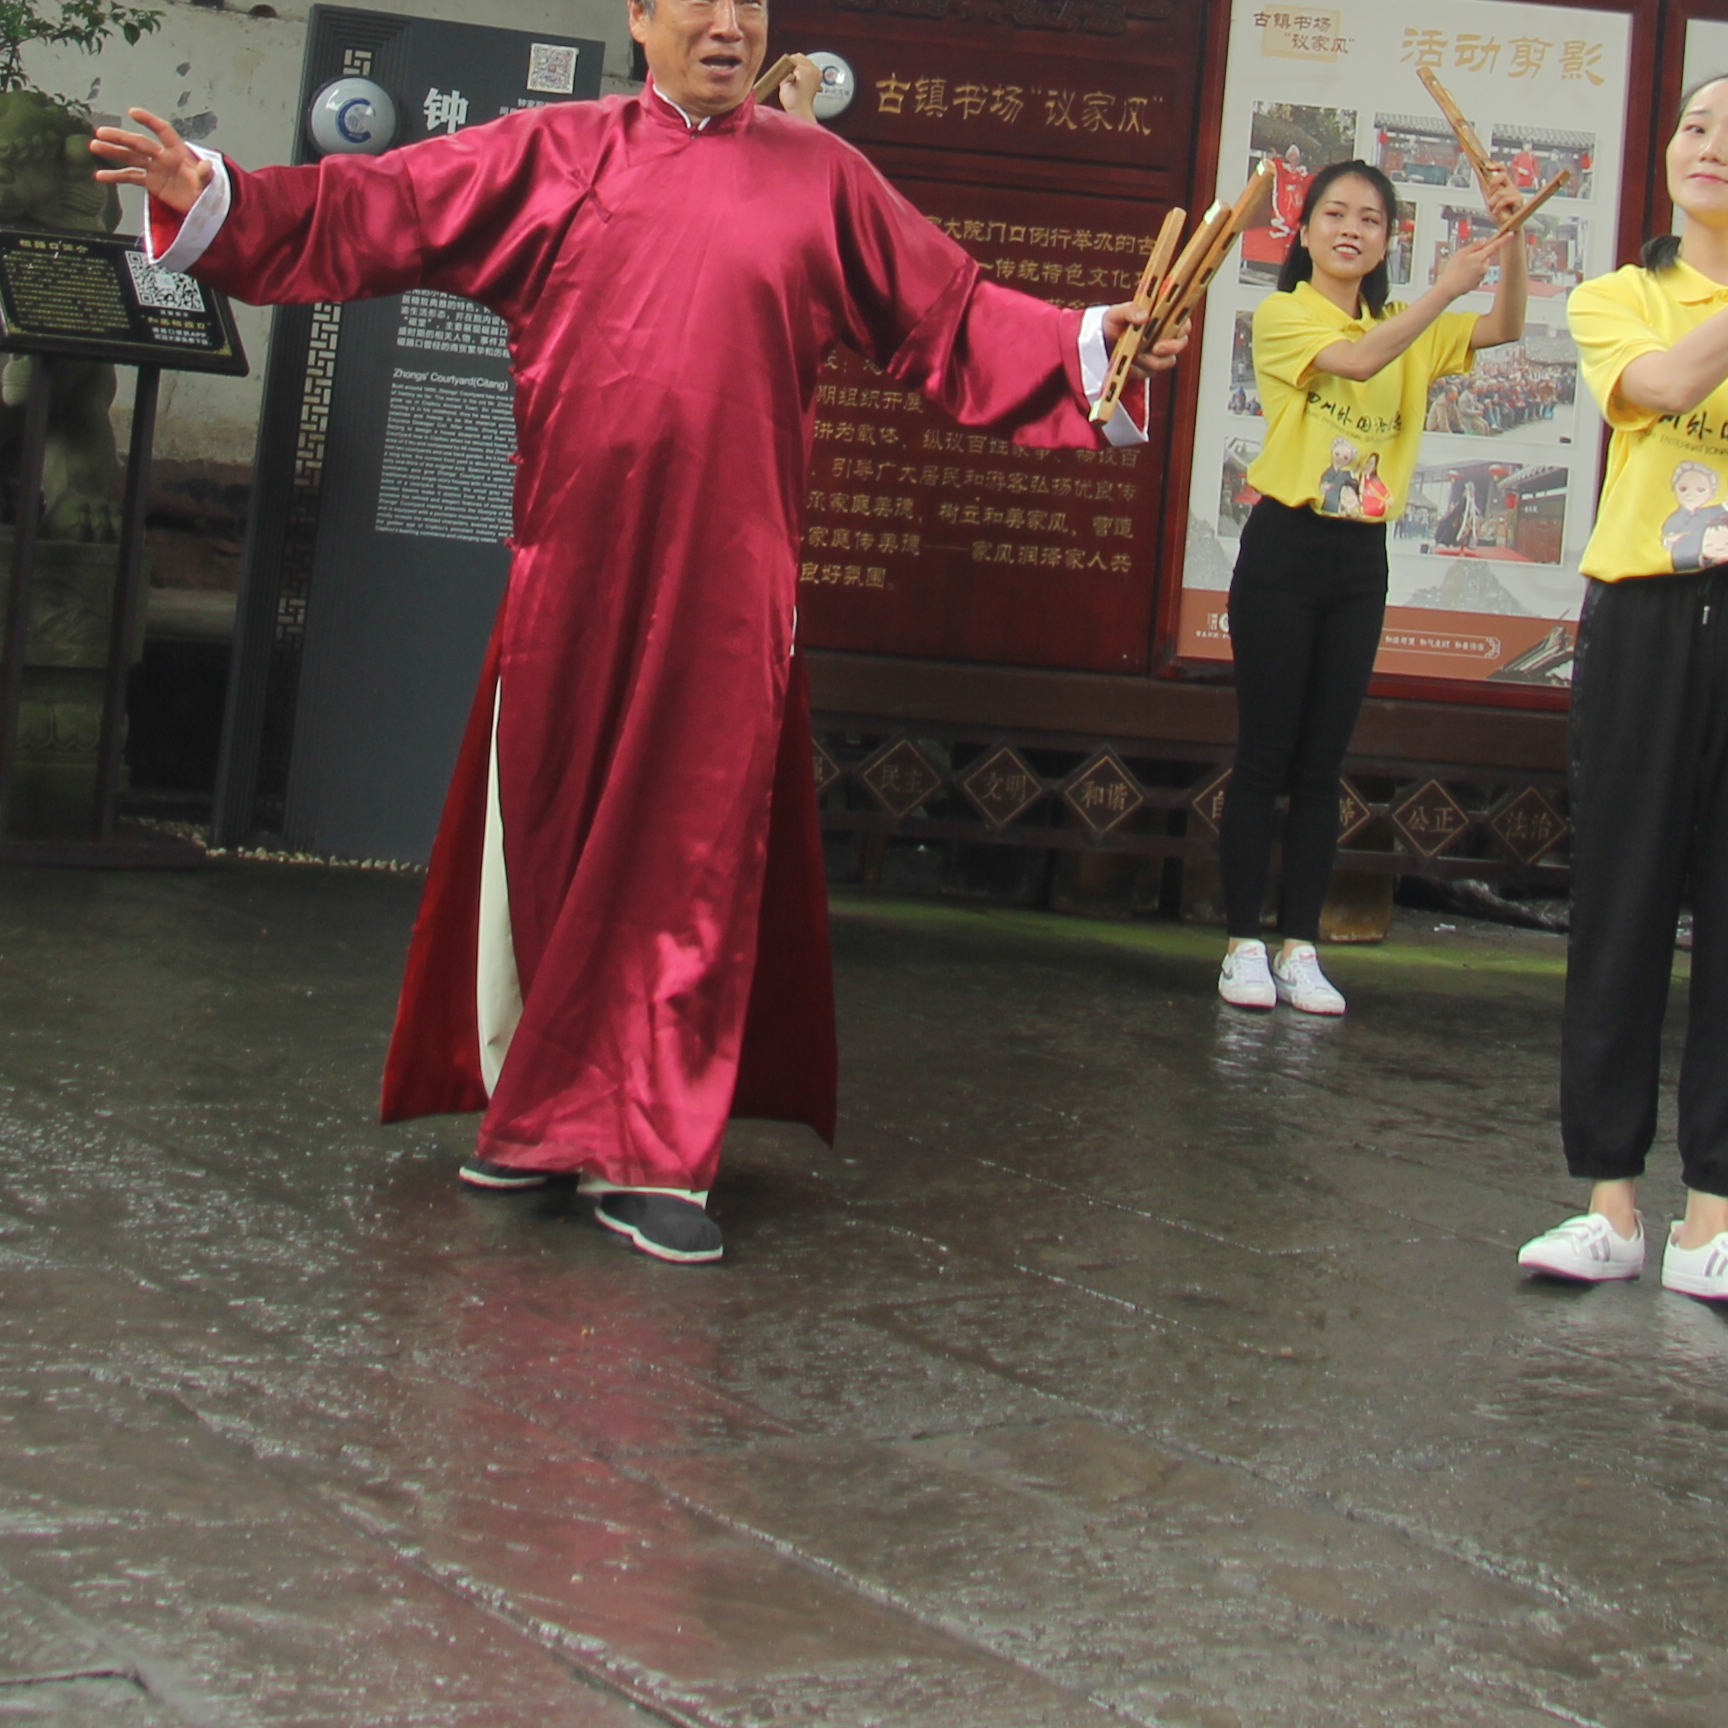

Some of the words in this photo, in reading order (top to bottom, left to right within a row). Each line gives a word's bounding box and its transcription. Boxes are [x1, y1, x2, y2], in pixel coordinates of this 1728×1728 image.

[1253, 12, 1332, 33] 古镇书场
[1400, 27, 1606, 86] 活动剪影
